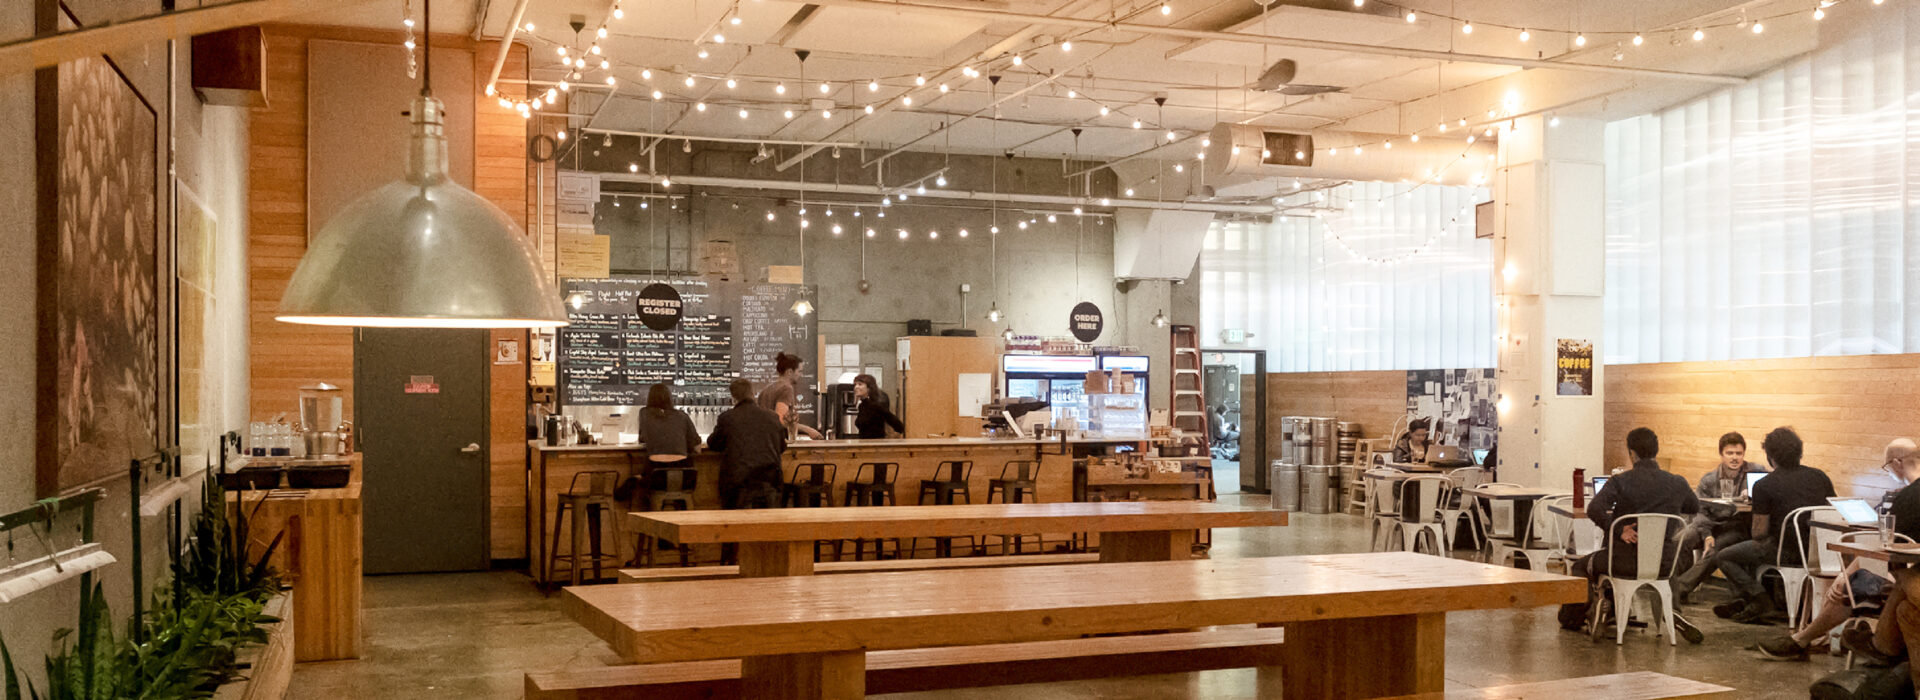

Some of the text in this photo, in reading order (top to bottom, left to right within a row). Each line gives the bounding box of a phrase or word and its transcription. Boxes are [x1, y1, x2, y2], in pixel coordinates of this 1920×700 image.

[639, 298, 681, 307] REGISTER
[643, 307, 677, 315] CLOSED
[1074, 314, 1100, 322] ORDER
[1078, 322, 1097, 330] HERE
[1559, 358, 1590, 369] COFFEE
